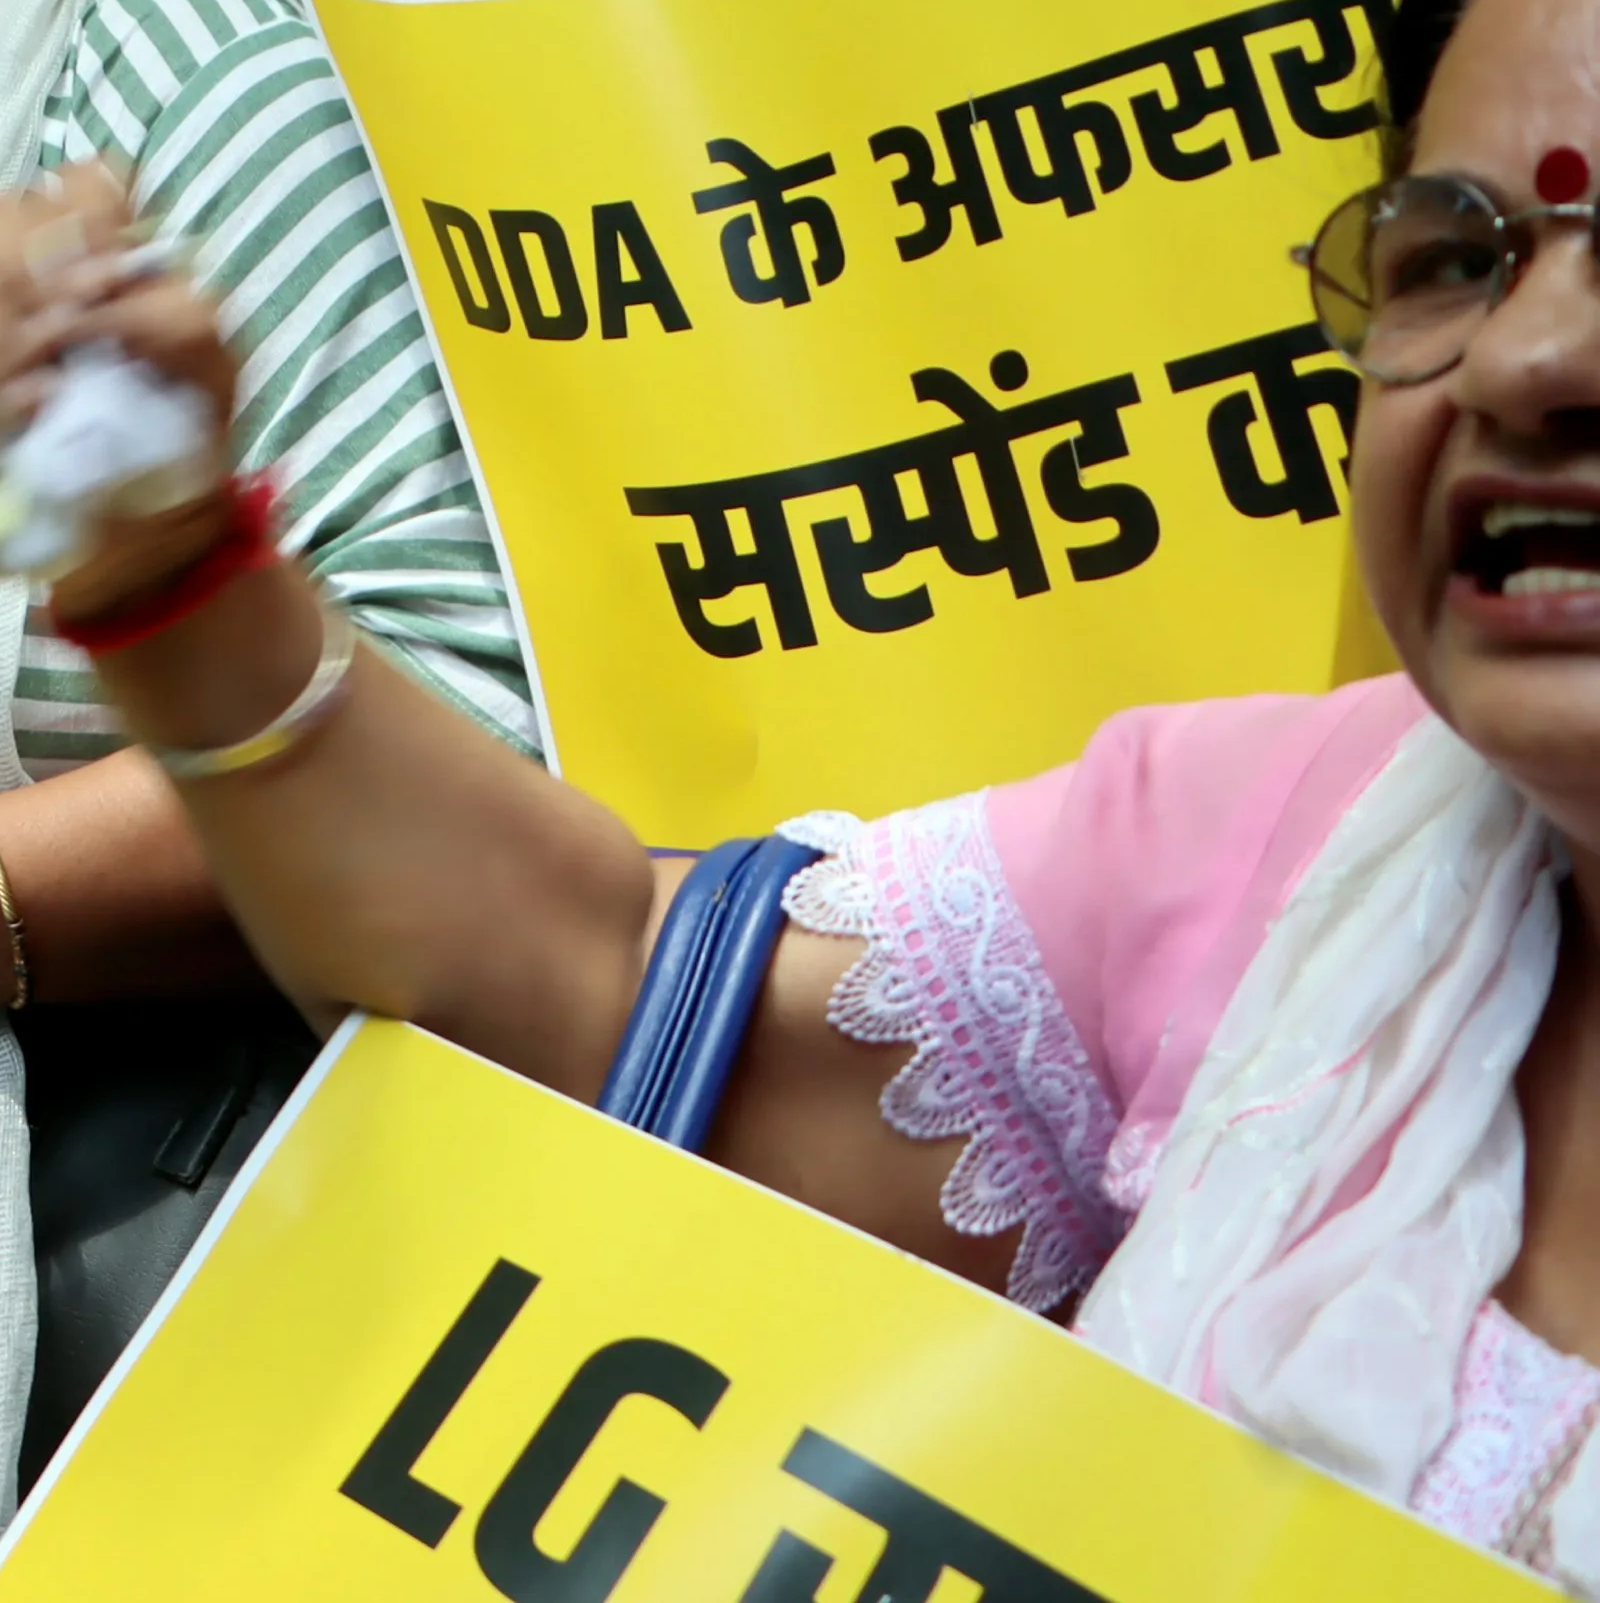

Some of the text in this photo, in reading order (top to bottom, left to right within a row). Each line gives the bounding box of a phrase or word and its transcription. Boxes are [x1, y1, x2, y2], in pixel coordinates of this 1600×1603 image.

[422, 198, 693, 342] DDA
[692, 137, 847, 309] के
[623, 349, 1162, 659] सस्पेंड
[338, 1256, 731, 1603] LG
